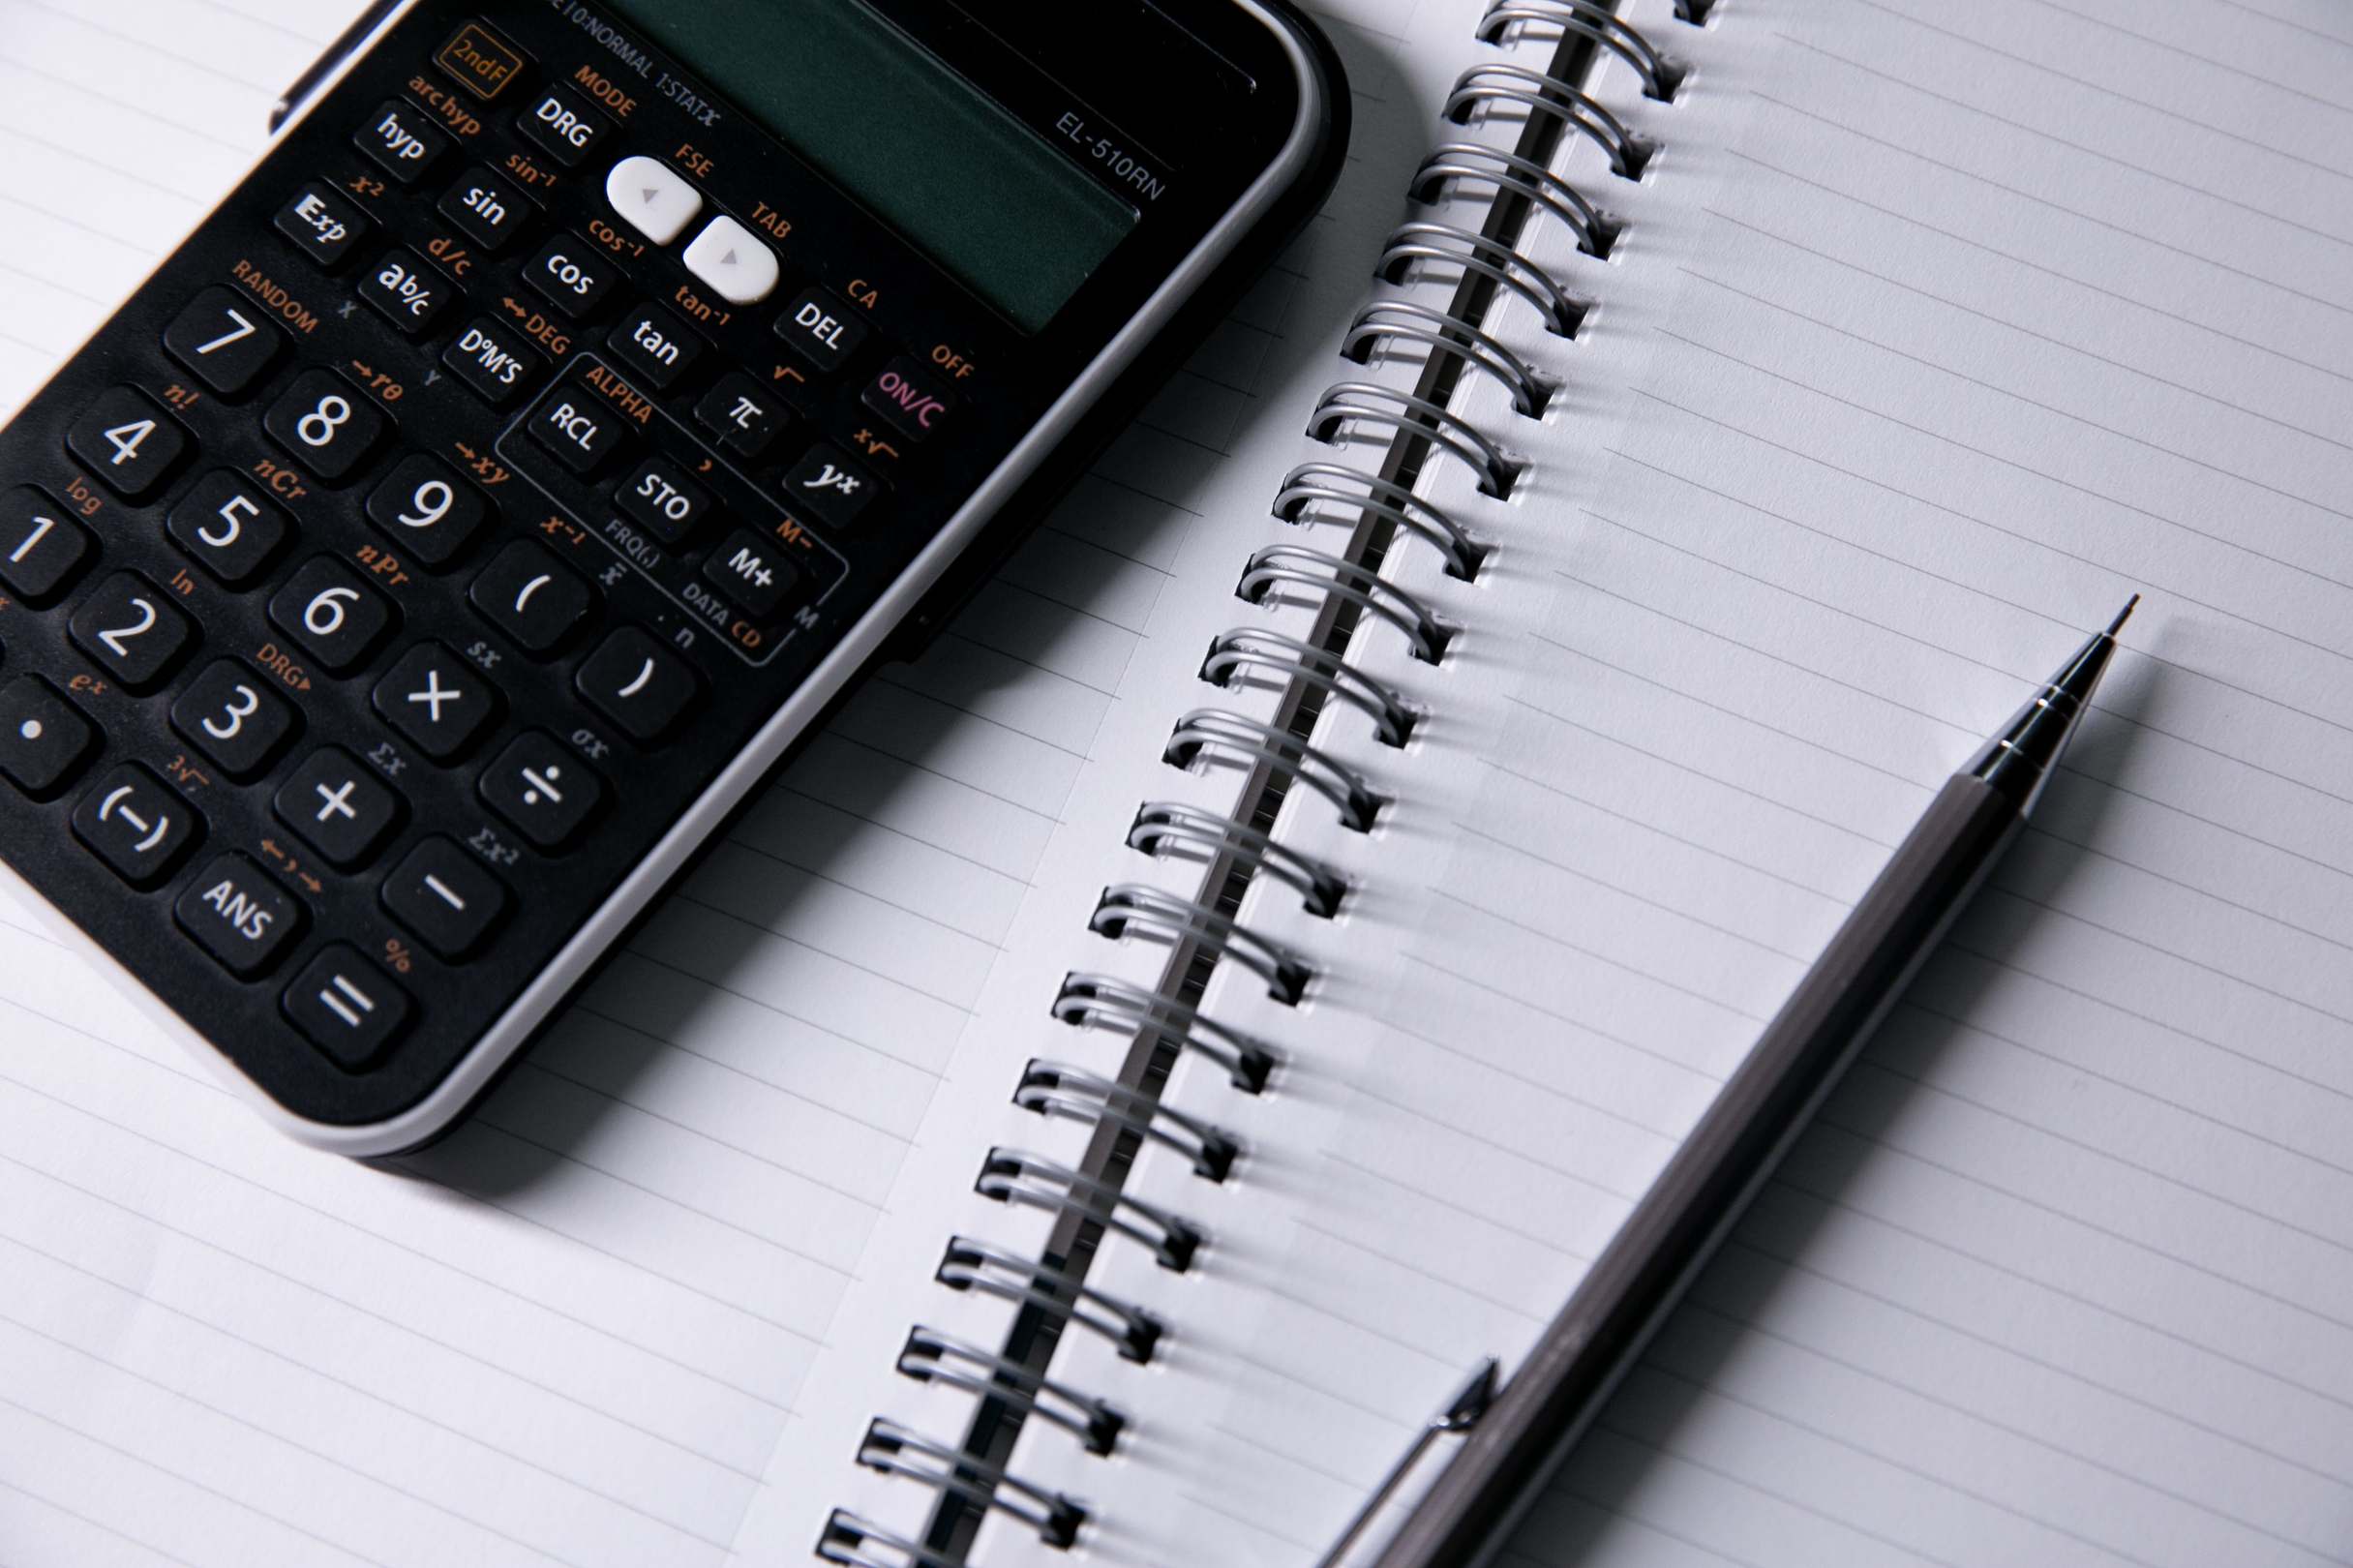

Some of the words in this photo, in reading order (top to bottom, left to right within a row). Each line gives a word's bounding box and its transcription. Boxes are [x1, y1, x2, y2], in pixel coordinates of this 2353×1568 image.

[453, 40, 508, 81] 2ndF
[575, 65, 637, 117] MODE
[377, 114, 425, 160] hyp
[536, 98, 593, 147] DRG
[676, 143, 715, 178] FSE
[1056, 111, 1165, 201] EL-510RN
[294, 194, 347, 243] Exp
[463, 187, 506, 226] sin
[750, 201, 792, 239] TAB
[428, 238, 472, 275] d/c
[547, 255, 594, 295] cos
[232, 259, 319, 334] RANDOM
[848, 279, 878, 309] CA
[196, 308, 256, 354] 7
[526, 314, 571, 355] DEG
[633, 320, 679, 367] tan
[795, 302, 844, 350] DEL
[931, 345, 974, 379] OFF
[164, 384, 200, 410] n!
[587, 366, 654, 424] ALPHA
[879, 372, 945, 427] ON/C
[104, 419, 156, 466] 4
[297, 395, 351, 446] 8
[551, 403, 597, 451] RCL
[66, 476, 104, 516] log
[254, 459, 307, 499] nCr
[636, 473, 690, 520] STO
[197, 495, 260, 547] 5
[398, 480, 453, 528] 9
[10, 517, 55, 563] 1
[170, 568, 194, 594] ln
[356, 545, 408, 586] nPr
[728, 548, 772, 588] M+
[99, 598, 156, 657] 2
[304, 587, 360, 635] 6
[682, 583, 728, 625] DATA
[731, 620, 762, 648] CD
[794, 606, 820, 628] M
[201, 685, 258, 739] 3
[201, 880, 272, 940] ANS
